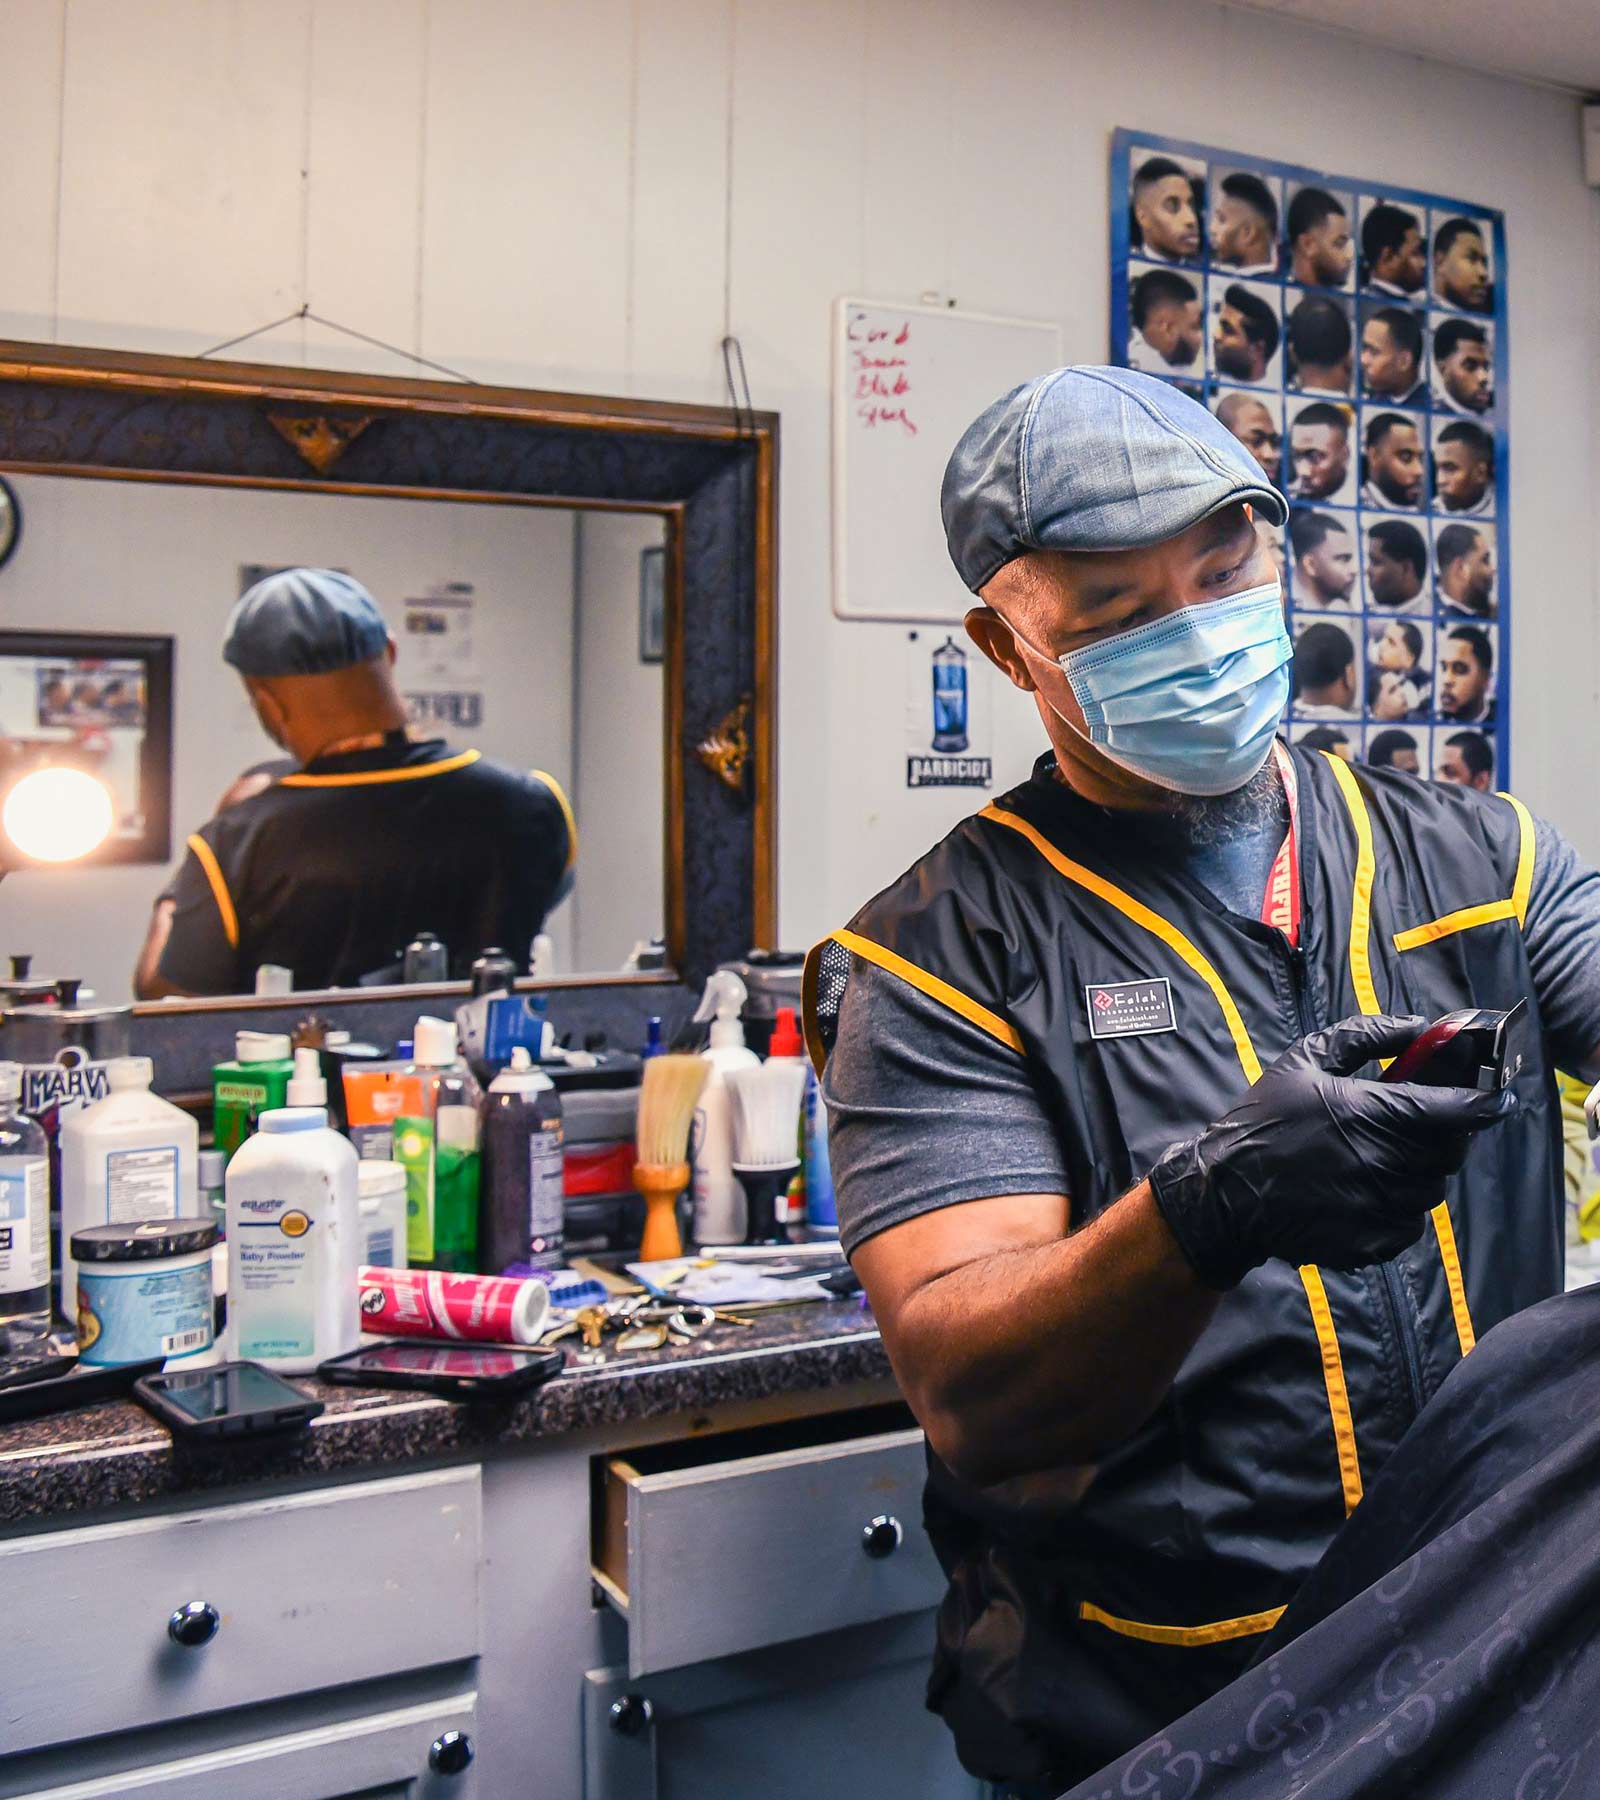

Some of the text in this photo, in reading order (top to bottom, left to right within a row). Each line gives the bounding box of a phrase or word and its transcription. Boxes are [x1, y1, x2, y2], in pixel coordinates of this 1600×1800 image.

[1114, 989, 1157, 1007] Falah
[240, 1199, 285, 1211] equate
[240, 1251, 306, 1263] Baby Powder
